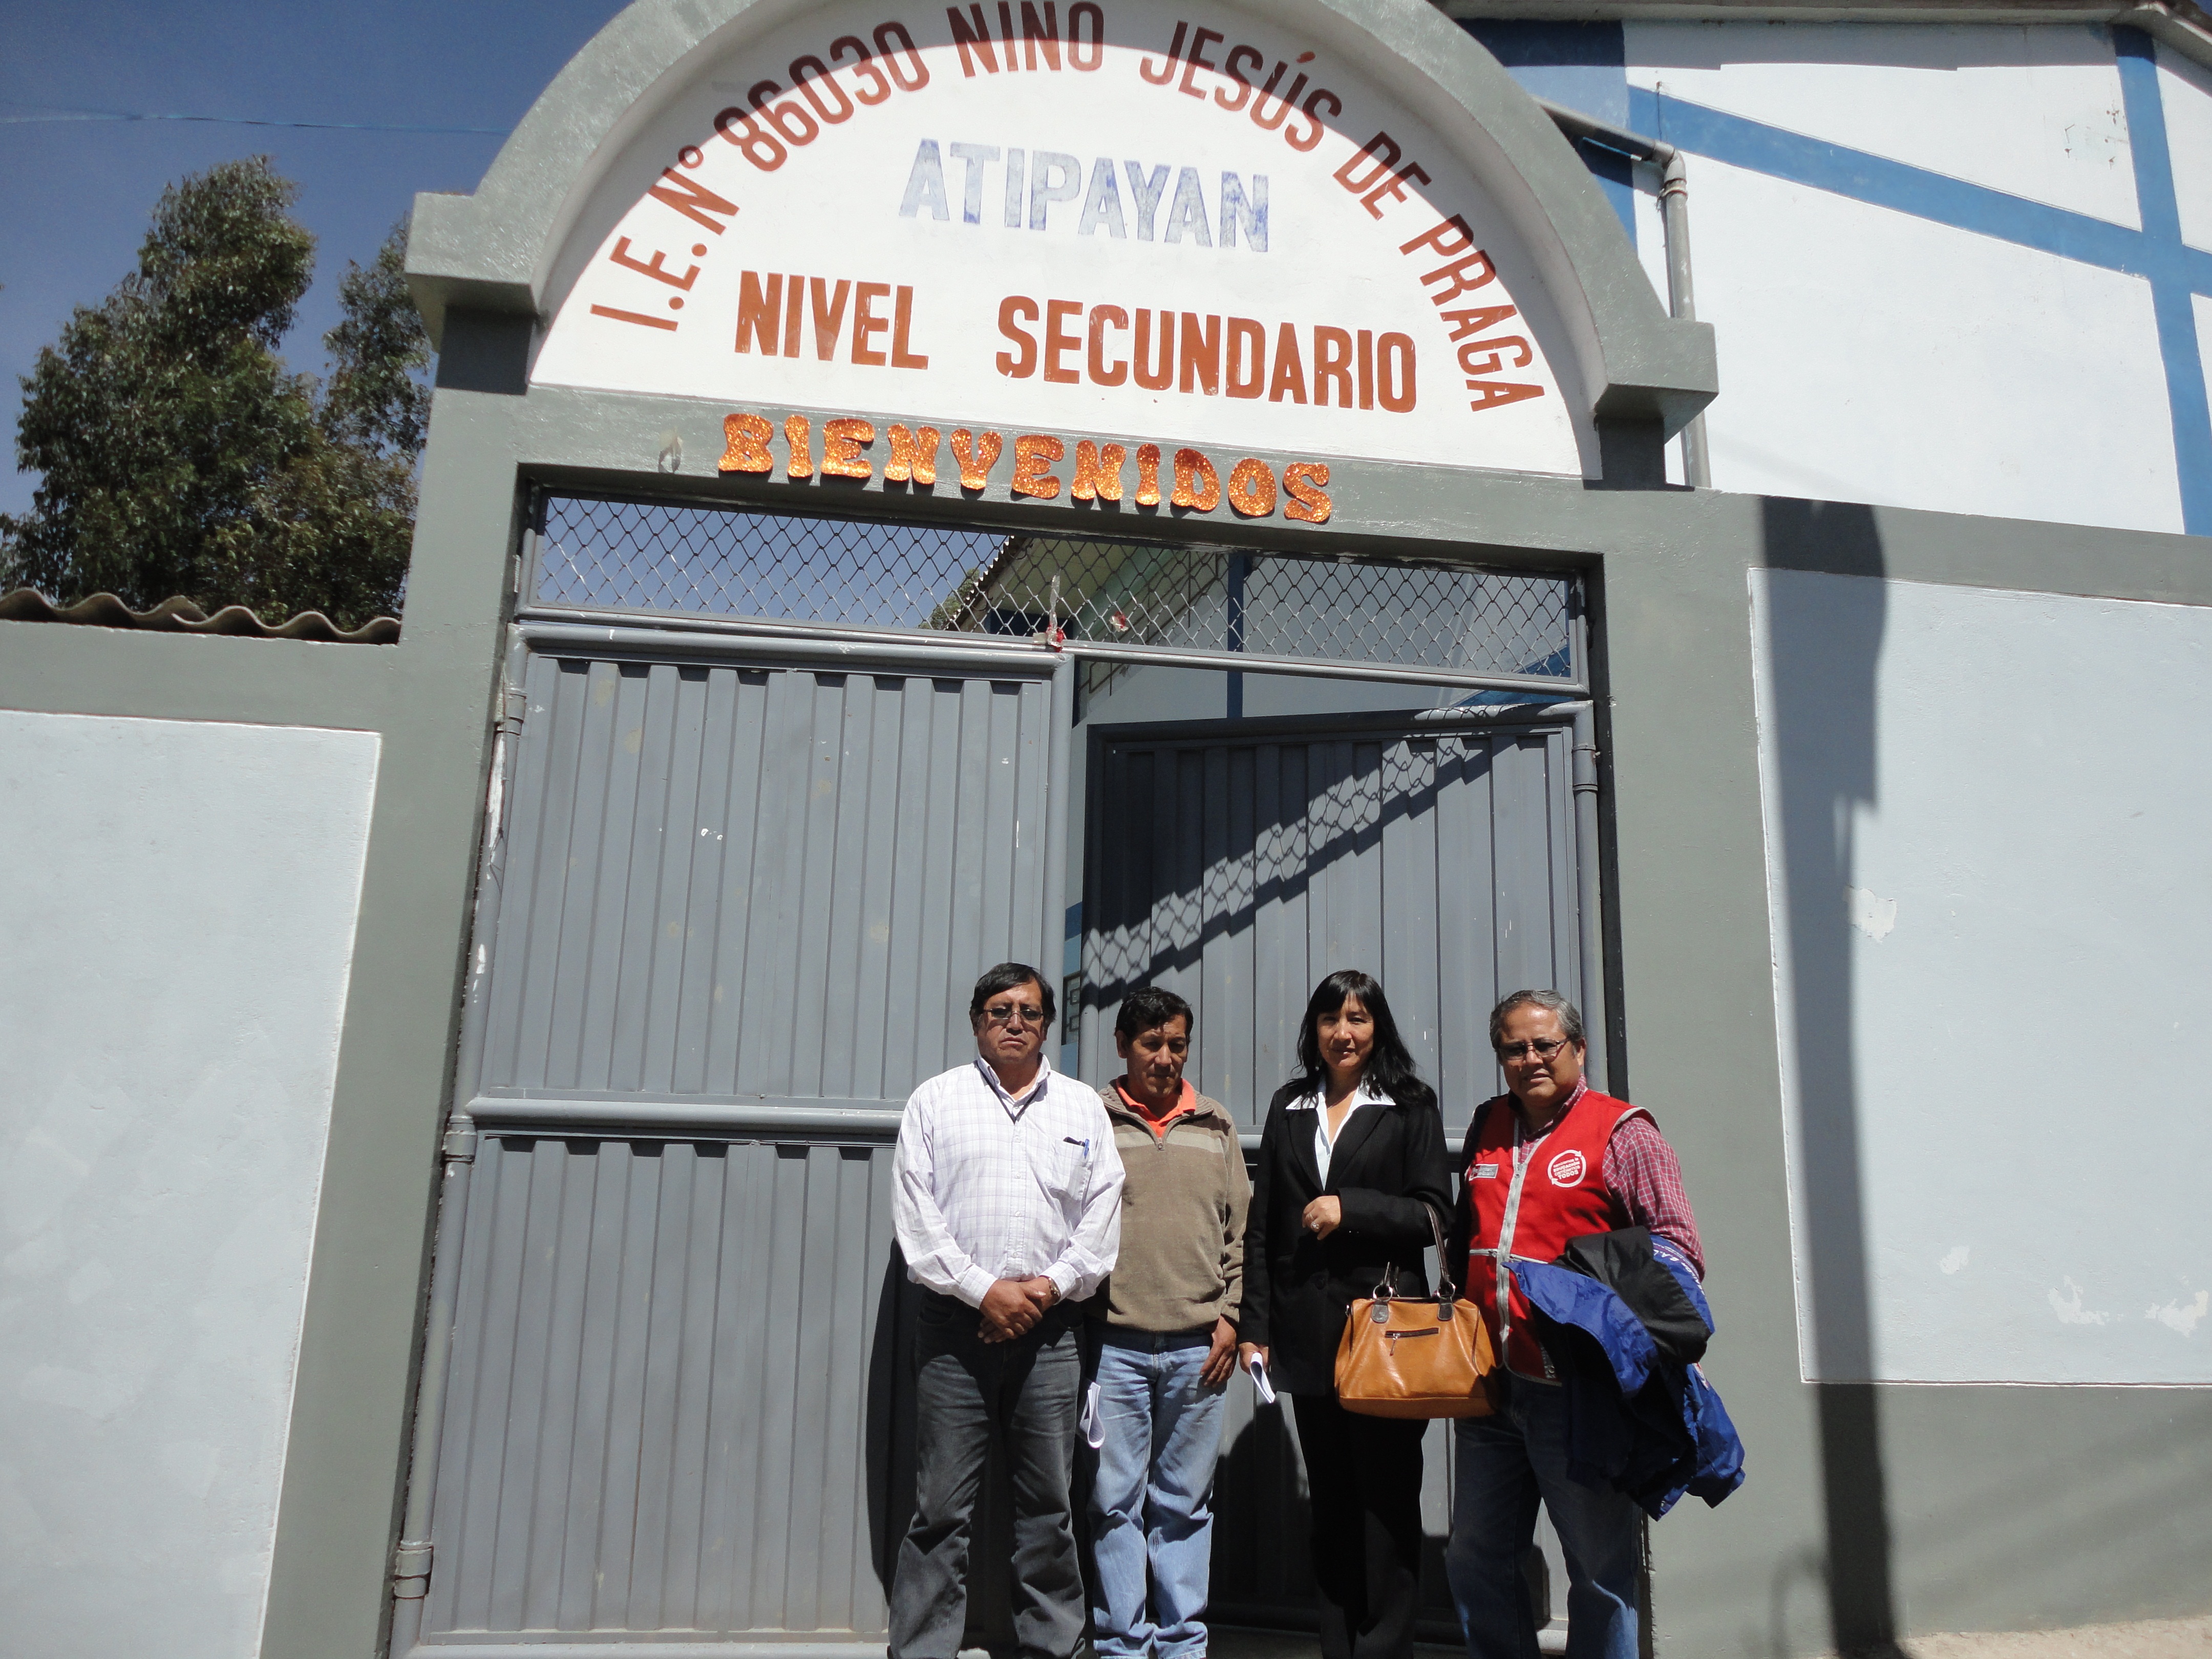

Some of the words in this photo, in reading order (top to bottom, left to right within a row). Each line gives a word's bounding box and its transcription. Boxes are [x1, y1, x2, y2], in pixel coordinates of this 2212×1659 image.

[714, 20, 929, 172] 86030
[1140, 20, 1343, 152] JESÚS
[1333, 131, 1432, 221] DE
[1399, 214, 1544, 412] PRAGA
[899, 139, 1268, 252] ATIPAYAN
[734, 270, 929, 370] NIVEL
[996, 295, 1416, 413] SECUNDARIO
[718, 414, 1332, 523] BIENVENIDOS
[1558, 1169, 1579, 1180] TODOS
